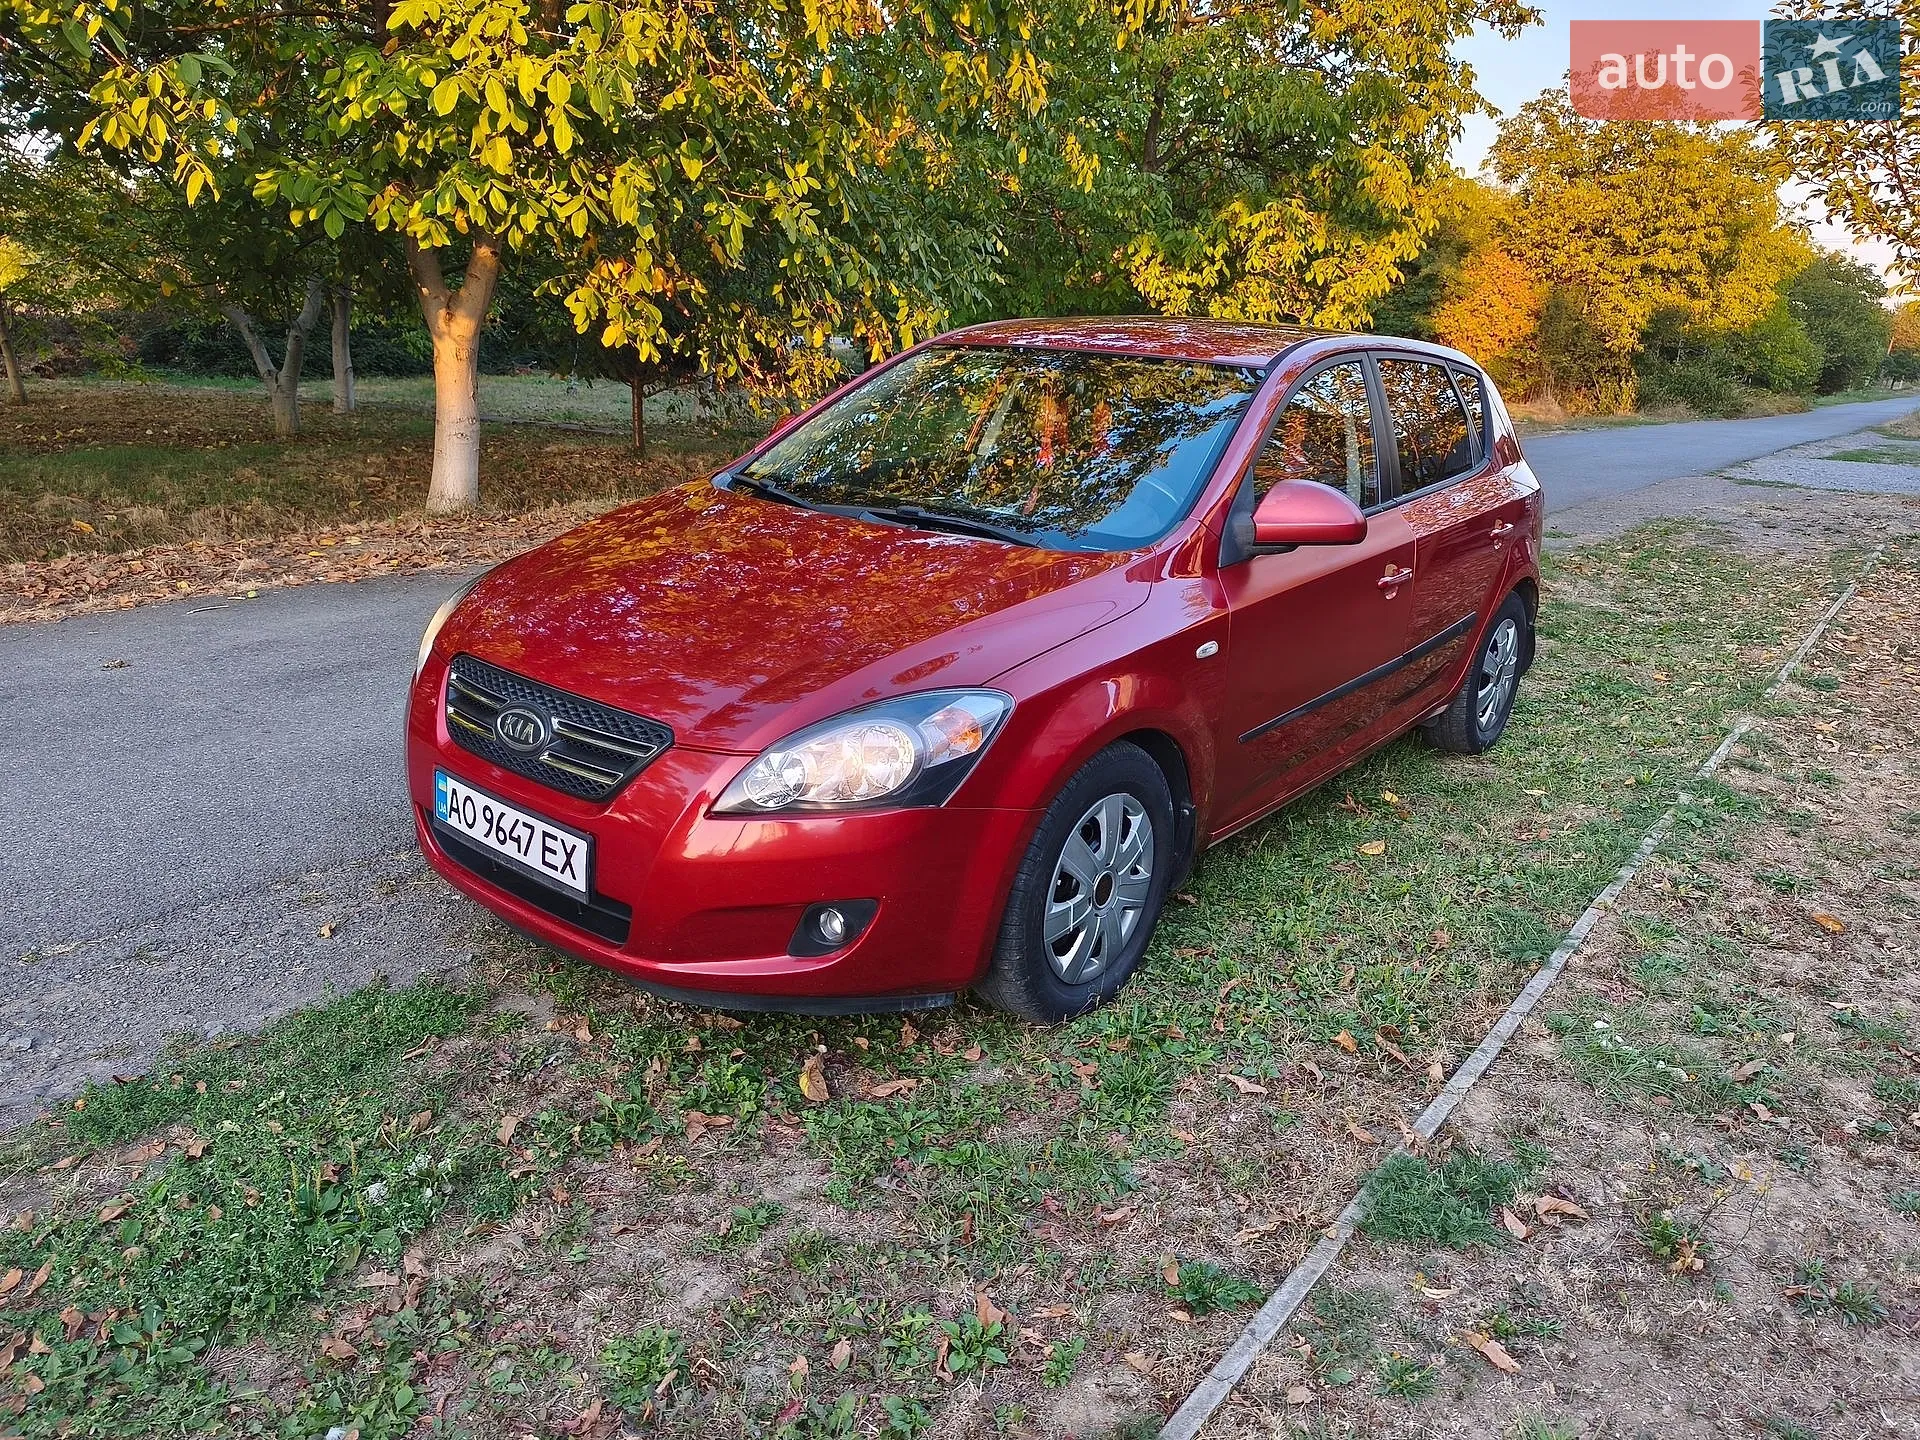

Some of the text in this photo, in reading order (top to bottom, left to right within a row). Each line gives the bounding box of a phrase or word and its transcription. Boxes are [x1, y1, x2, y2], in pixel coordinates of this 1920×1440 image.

[503, 714, 536, 744] KIA
[438, 801, 447, 815] UA
[449, 788, 577, 881] AO 9647 EX
